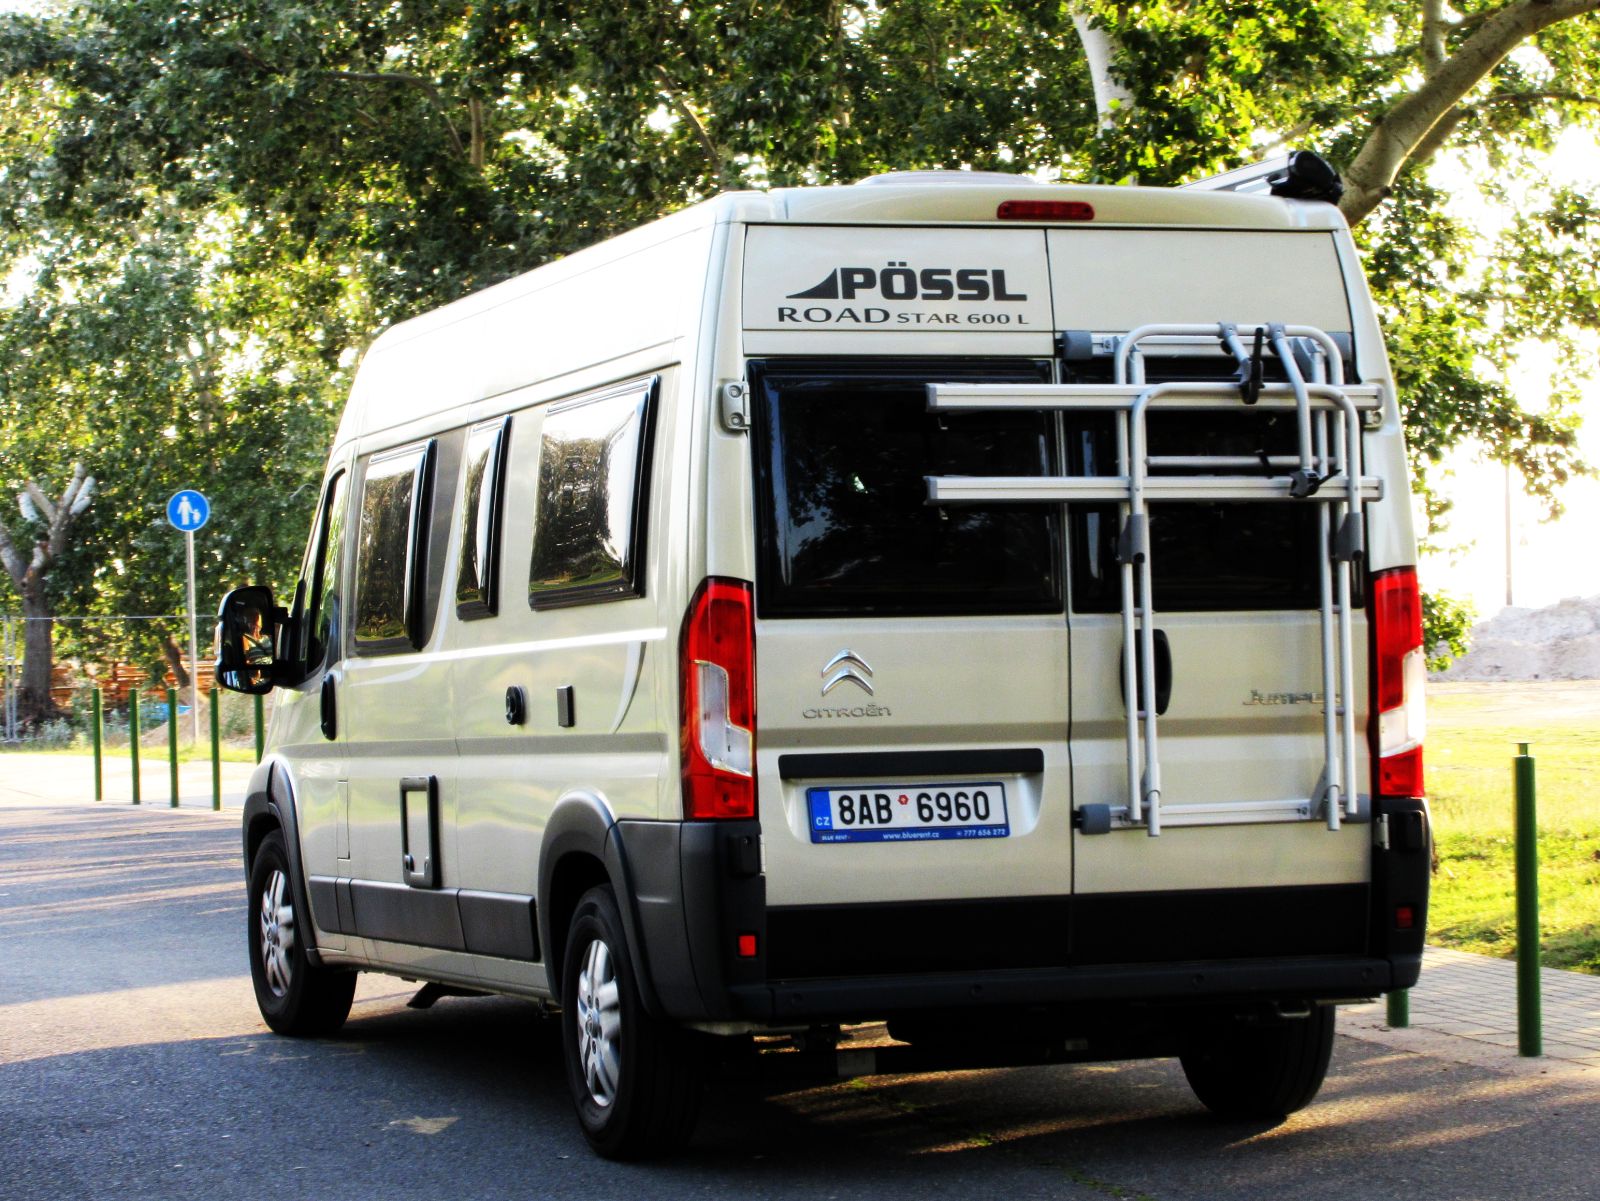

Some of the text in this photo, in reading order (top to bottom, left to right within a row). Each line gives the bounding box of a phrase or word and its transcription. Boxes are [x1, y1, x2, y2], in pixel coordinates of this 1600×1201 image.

[840, 261, 1027, 301] PÖSSL
[777, 307, 1029, 325] ROAD STAR 600 L
[838, 790, 990, 826] 8AB 6960
[815, 816, 831, 827] CZ
[882, 831, 940, 840] www.bluerent.cz
[964, 829, 976, 837] 777
